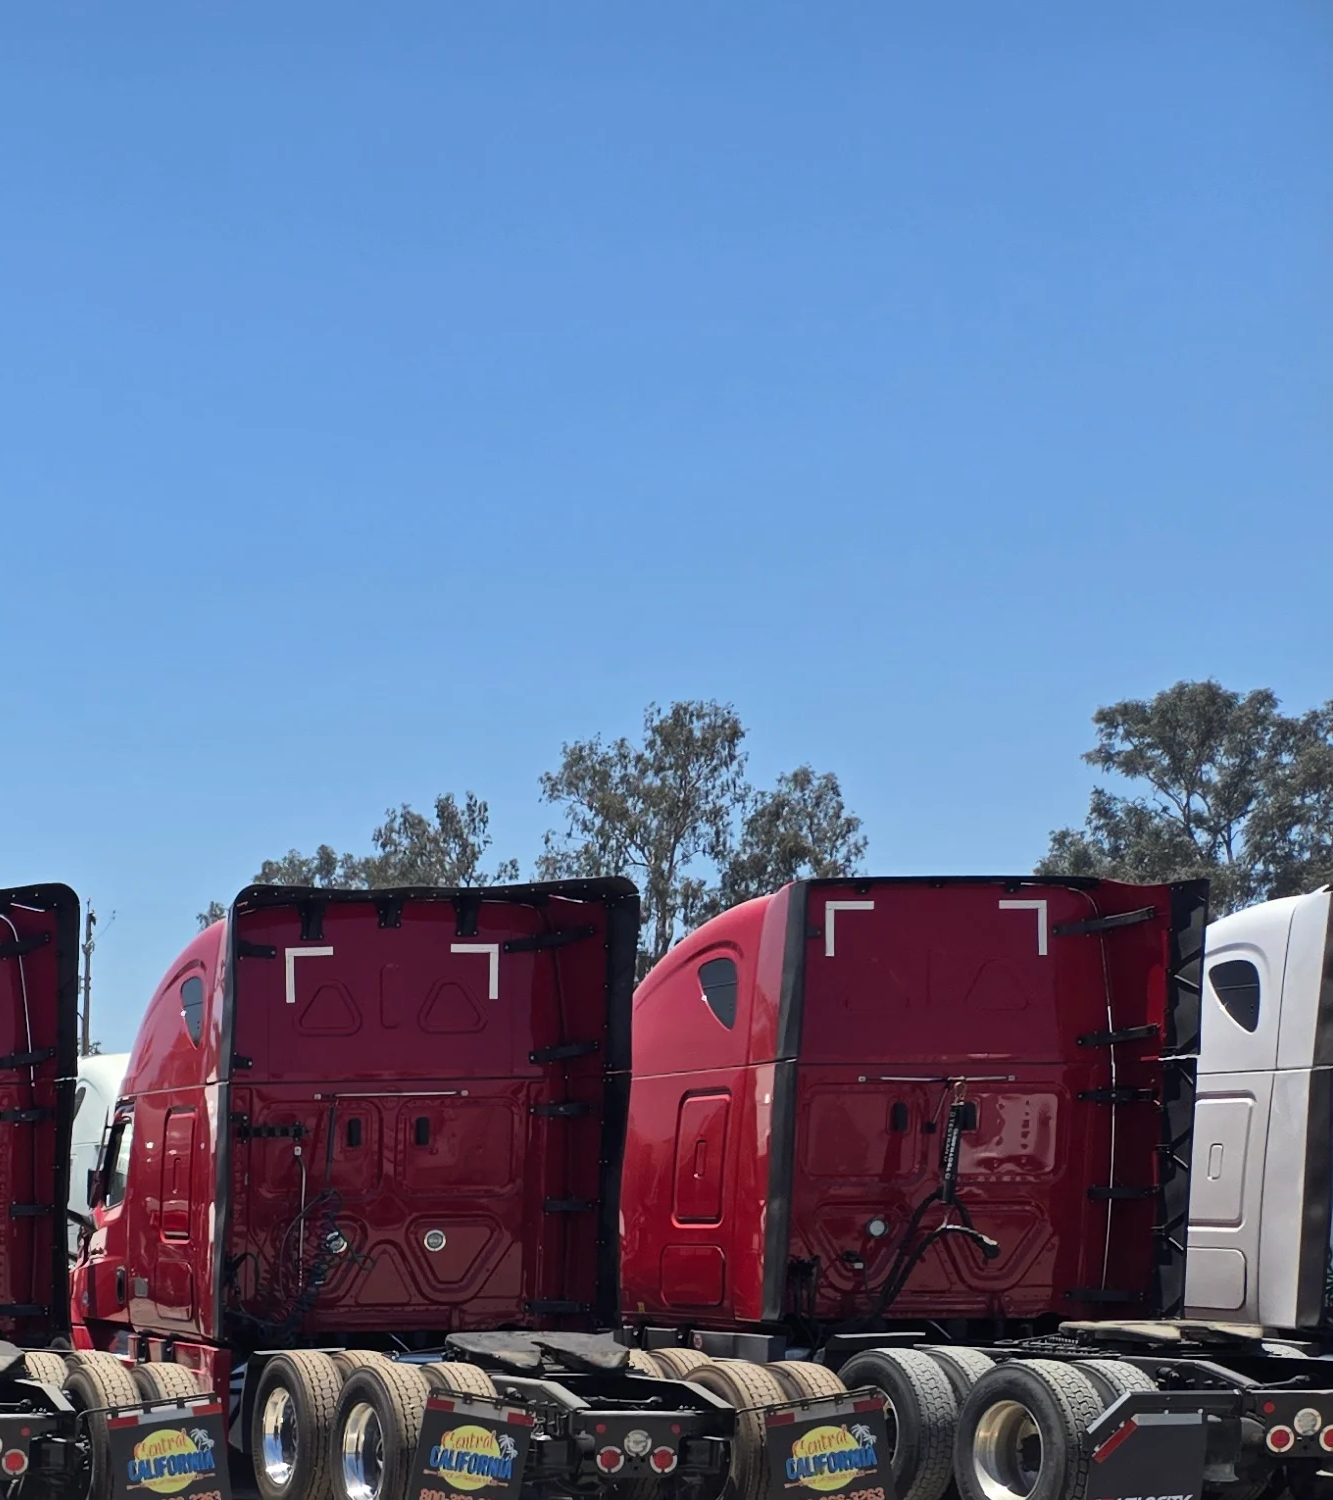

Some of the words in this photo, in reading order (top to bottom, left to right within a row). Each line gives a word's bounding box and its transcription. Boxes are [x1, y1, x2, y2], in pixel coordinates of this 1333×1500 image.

[128, 1449, 215, 1481] CALIFORNIA
[429, 1445, 512, 1479] CALIFORNIA
[785, 1443, 878, 1480] CALIFORNIA
